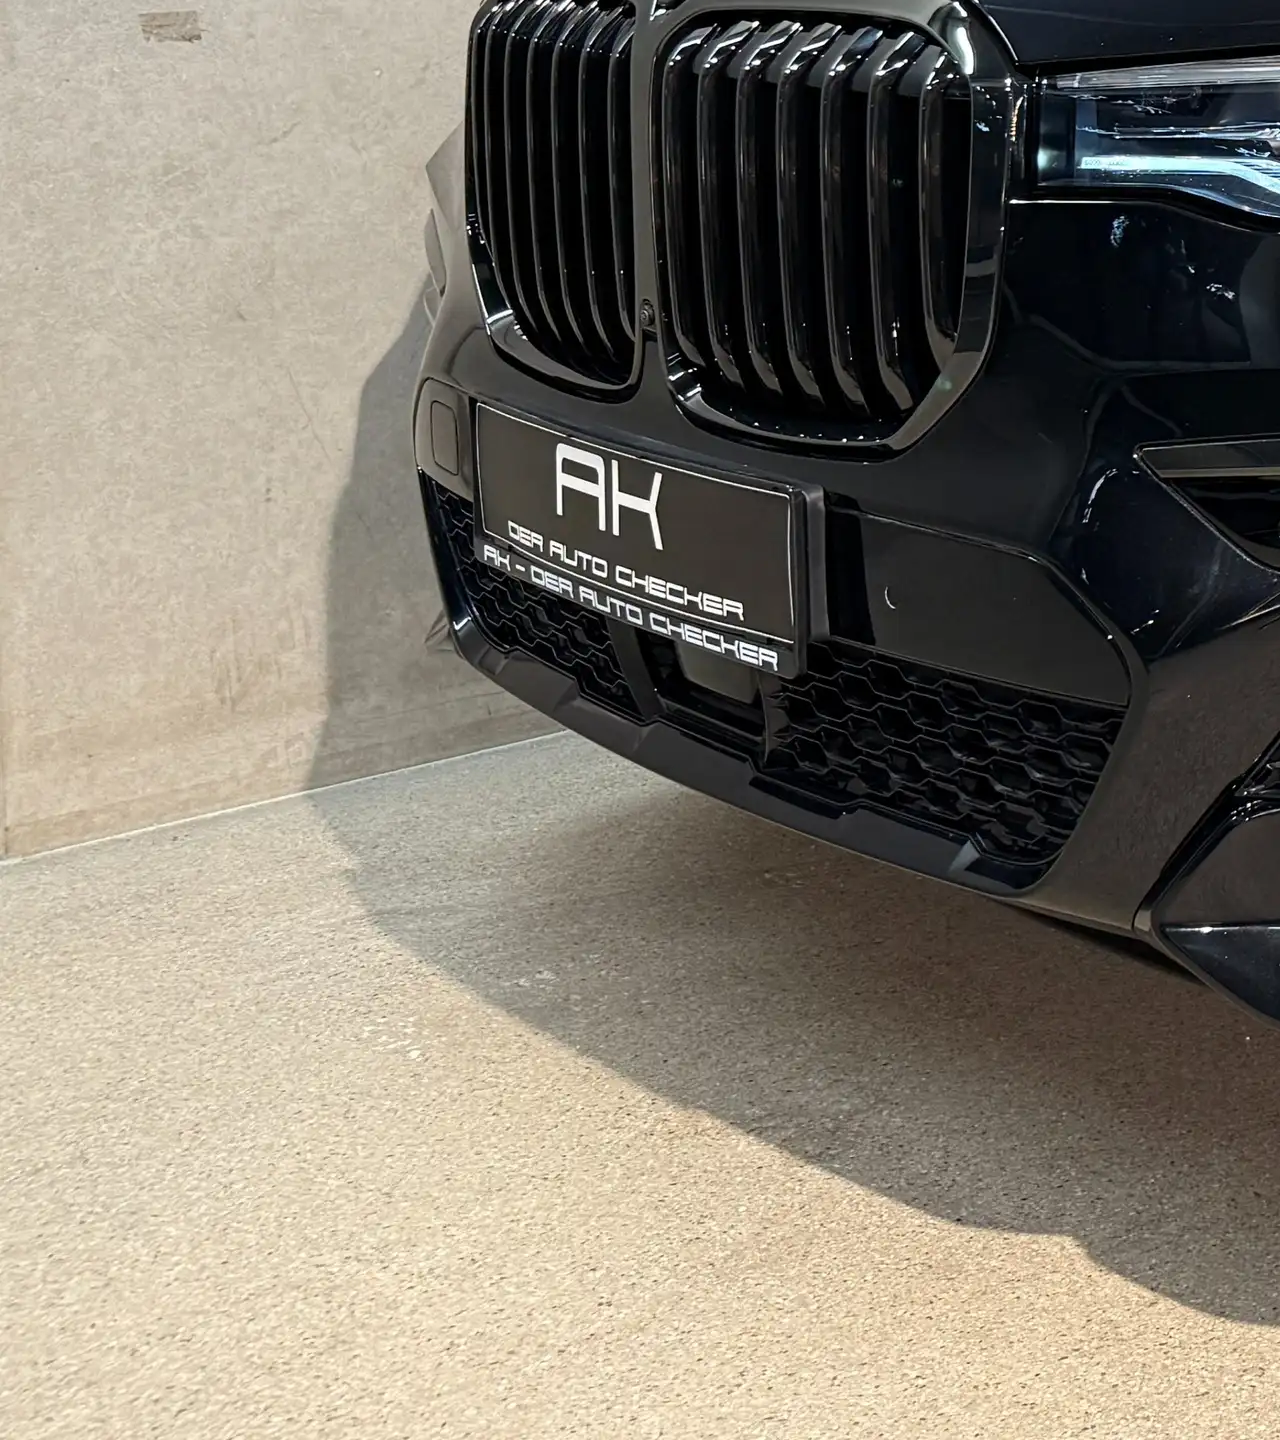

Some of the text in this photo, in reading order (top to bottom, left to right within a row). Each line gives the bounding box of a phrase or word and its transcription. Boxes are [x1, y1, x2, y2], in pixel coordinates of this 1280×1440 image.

[556, 443, 663, 550] AK
[483, 544, 511, 572] AK
[530, 565, 574, 599] DER
[579, 585, 644, 626] AUTO
[649, 612, 779, 672] CHECKER
[508, 520, 745, 621] DER AUTO CHECKER
